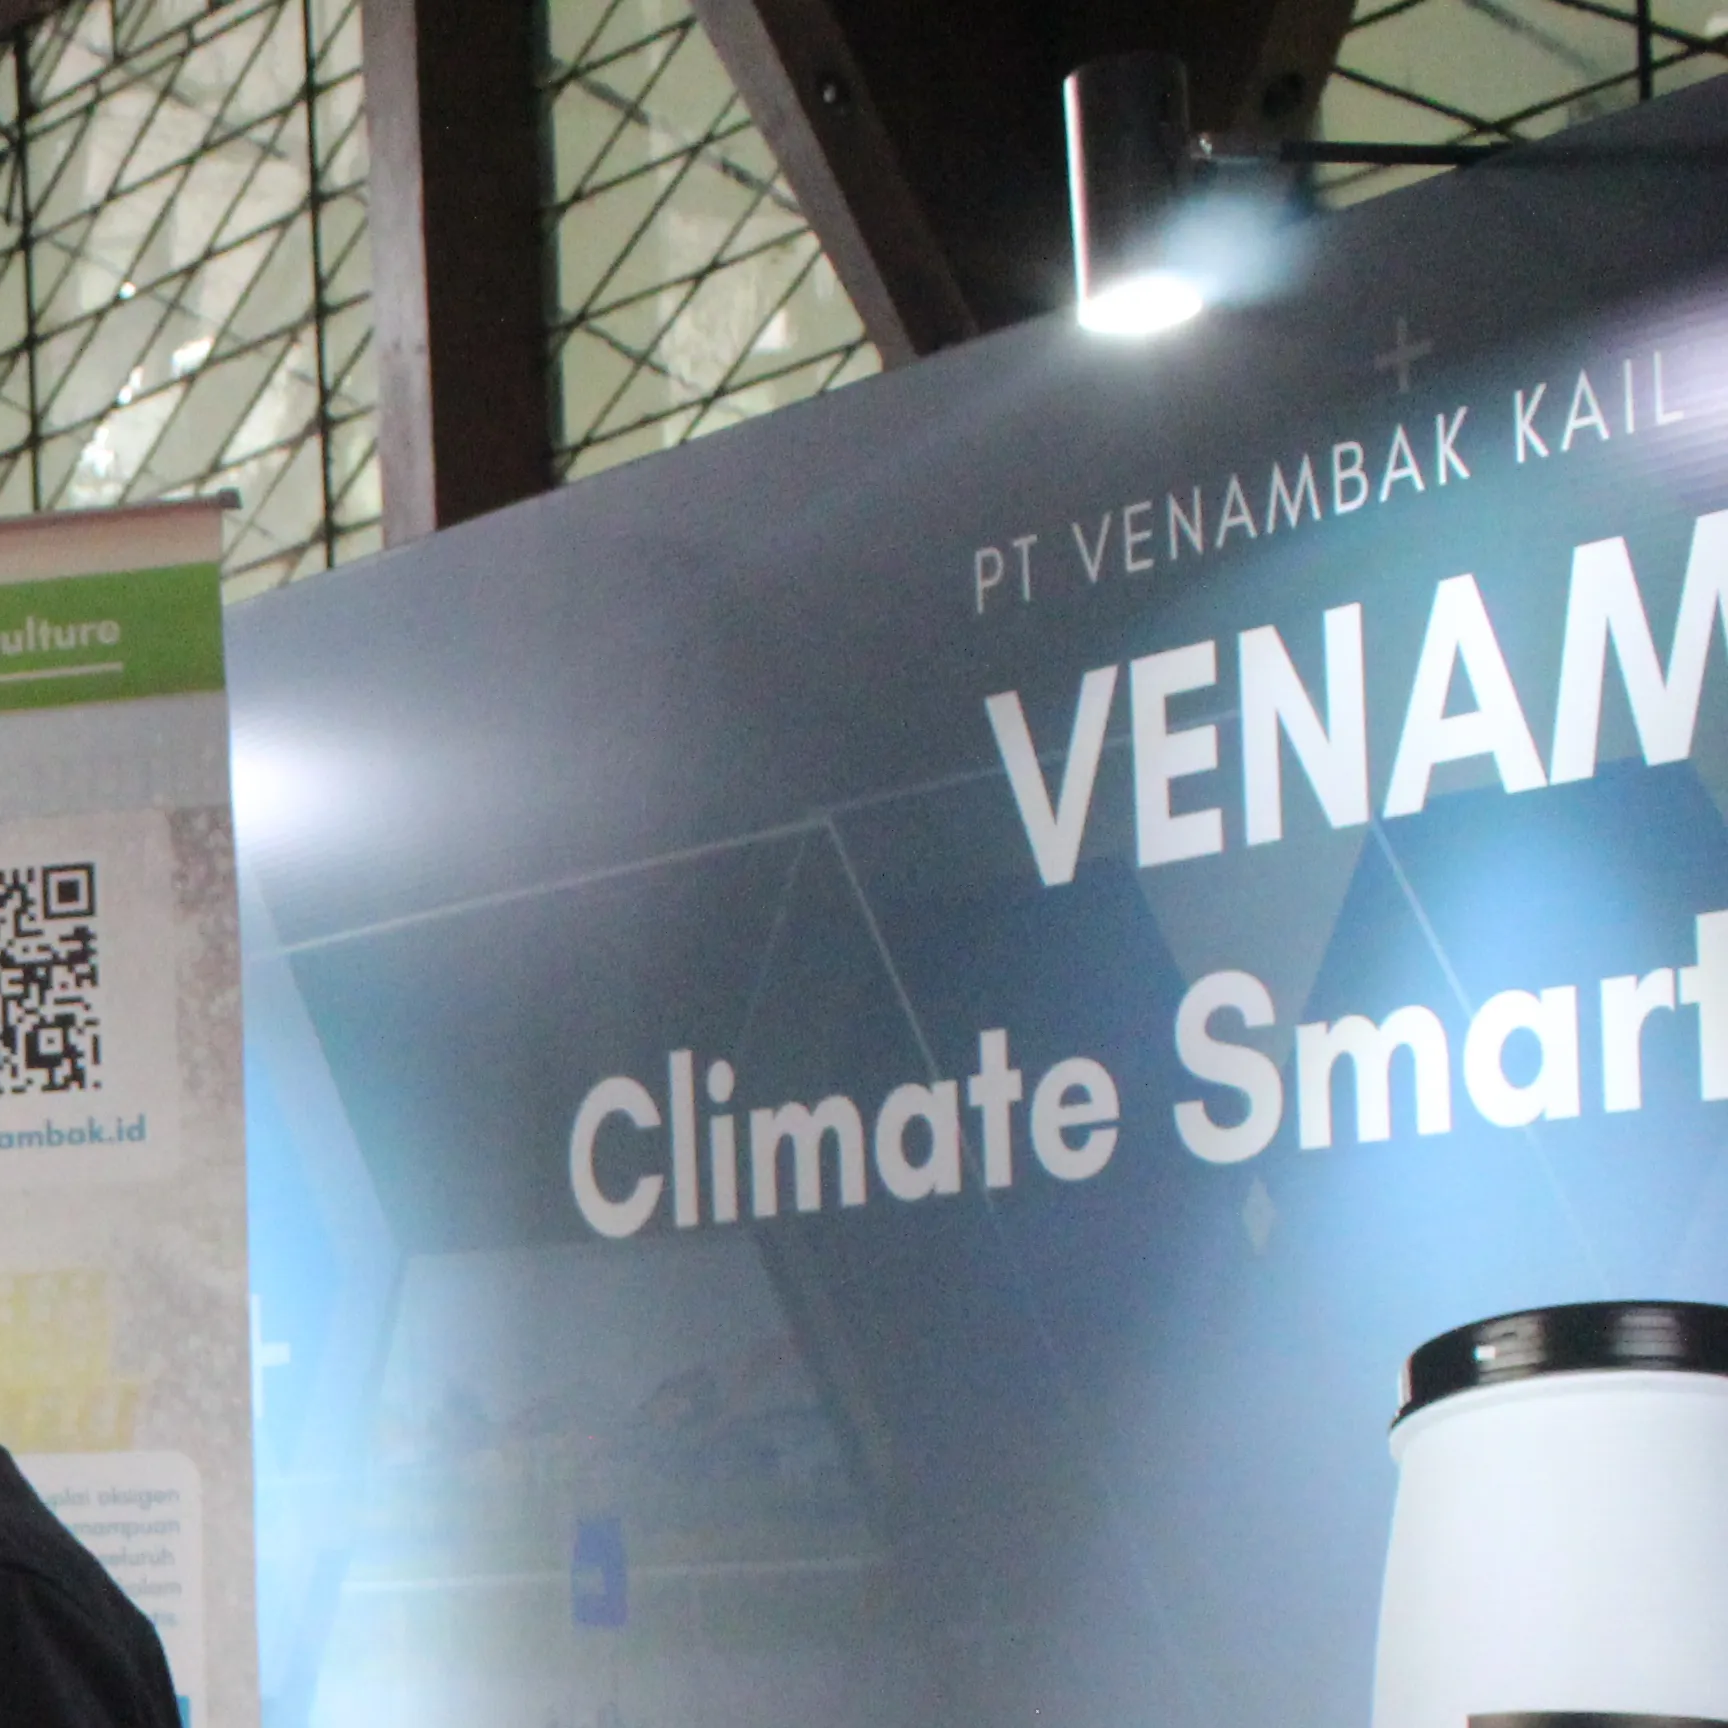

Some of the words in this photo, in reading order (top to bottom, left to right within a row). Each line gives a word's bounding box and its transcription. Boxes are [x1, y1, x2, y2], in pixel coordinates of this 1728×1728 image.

[975, 534, 1038, 614] PT
[1072, 406, 1470, 583] VENAMBAK
[570, 1028, 1121, 1238] Climate
[1173, 910, 1728, 1164] Smart
